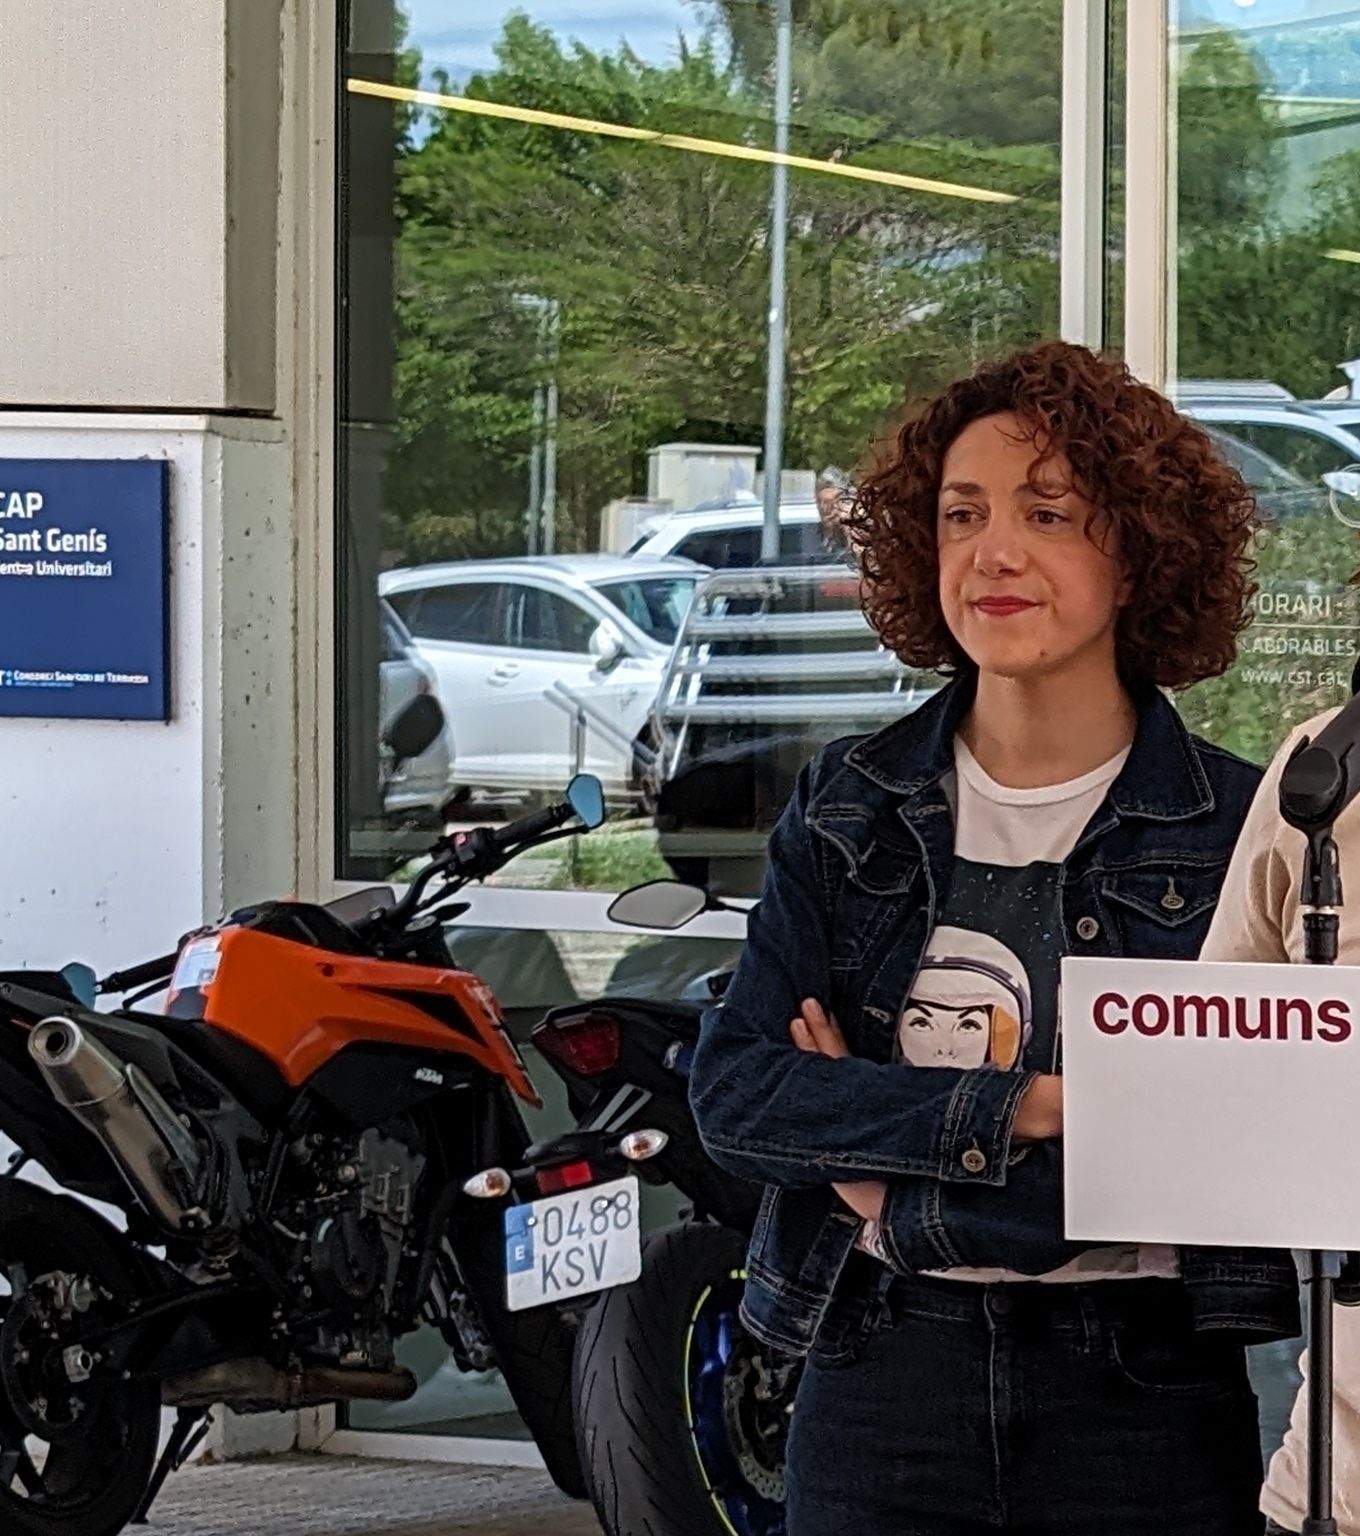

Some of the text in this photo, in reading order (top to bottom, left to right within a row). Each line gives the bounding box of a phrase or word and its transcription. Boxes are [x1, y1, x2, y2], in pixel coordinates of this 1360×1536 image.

[46, 528, 108, 553] Genís
[36, 560, 112, 576] Universitari
[1093, 992, 1352, 1043] comuns
[543, 1190, 632, 1247] 0488
[514, 1244, 526, 1261] E
[541, 1239, 608, 1295] KSV
